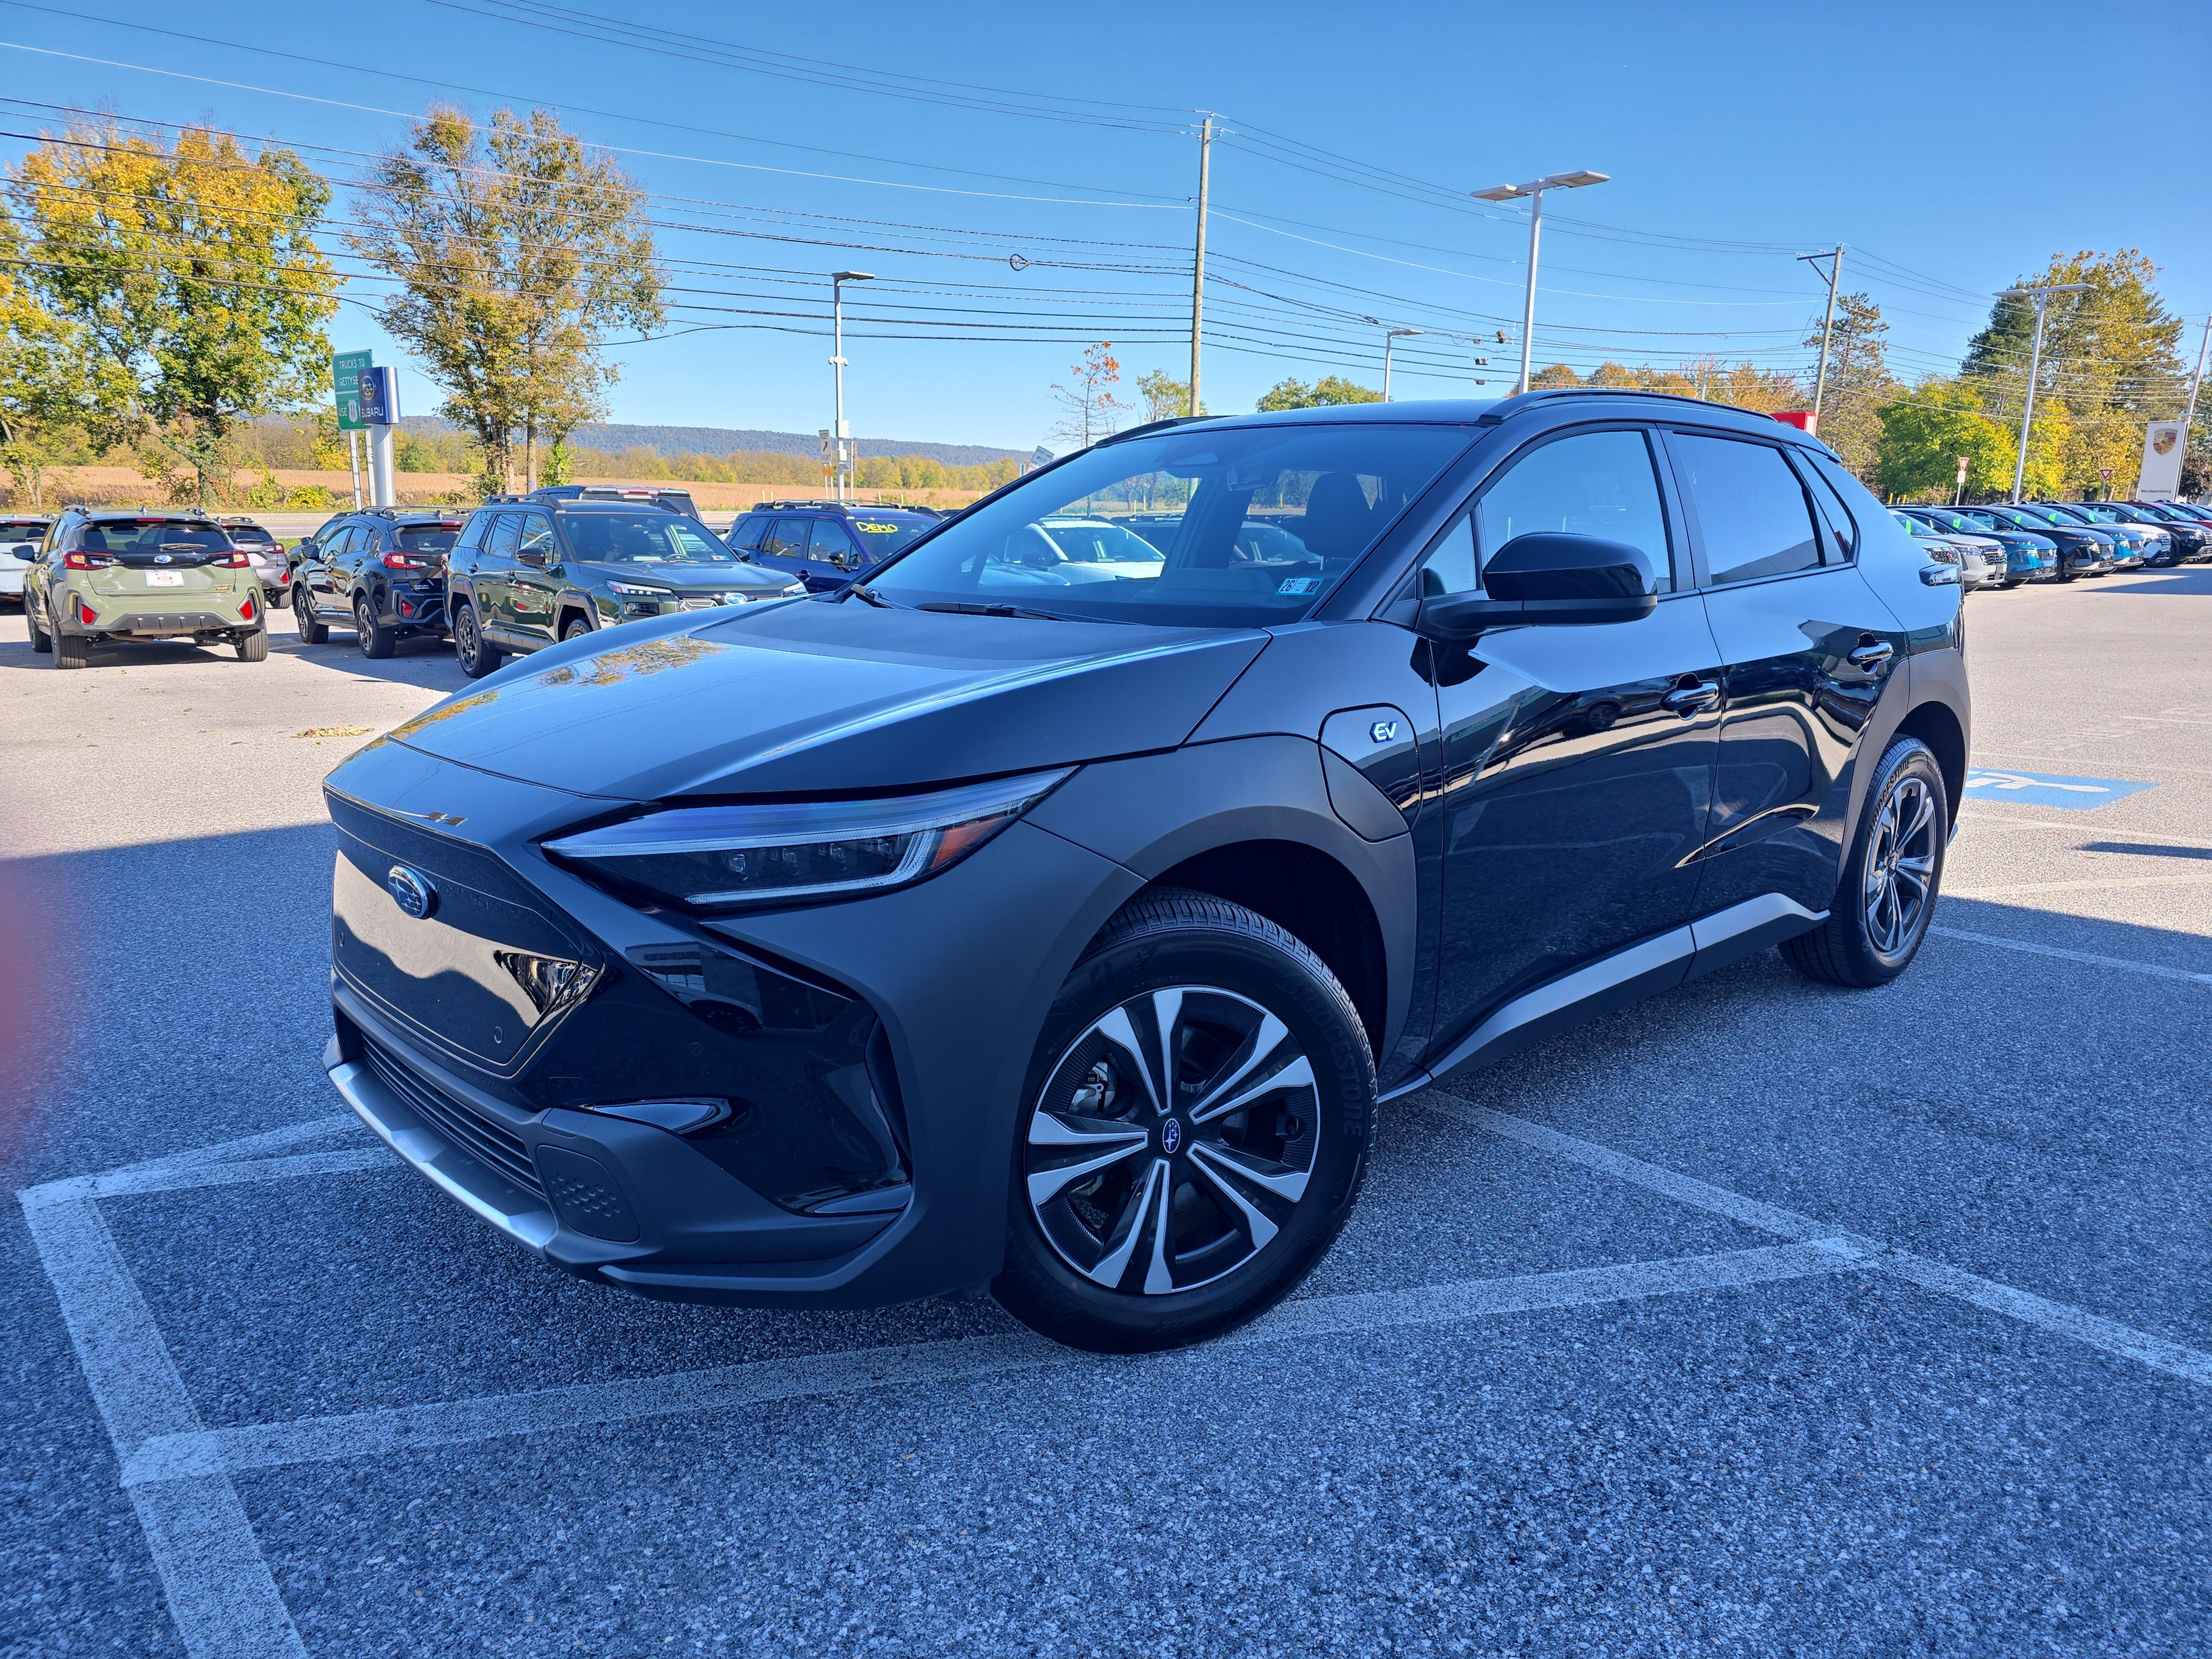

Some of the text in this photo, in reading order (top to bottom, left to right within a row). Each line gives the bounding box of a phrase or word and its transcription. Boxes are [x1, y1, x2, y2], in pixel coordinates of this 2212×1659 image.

[339, 358, 365, 370] TRUCKS TO
[338, 407, 347, 416] USE
[350, 404, 355, 417] 11
[361, 406, 383, 418] SUBARU
[856, 522, 898, 532] DEMO
[1280, 580, 1320, 593] 26 12
[1370, 721, 1397, 743] EV
[1274, 974, 1362, 1136] BRIDGESTONE
